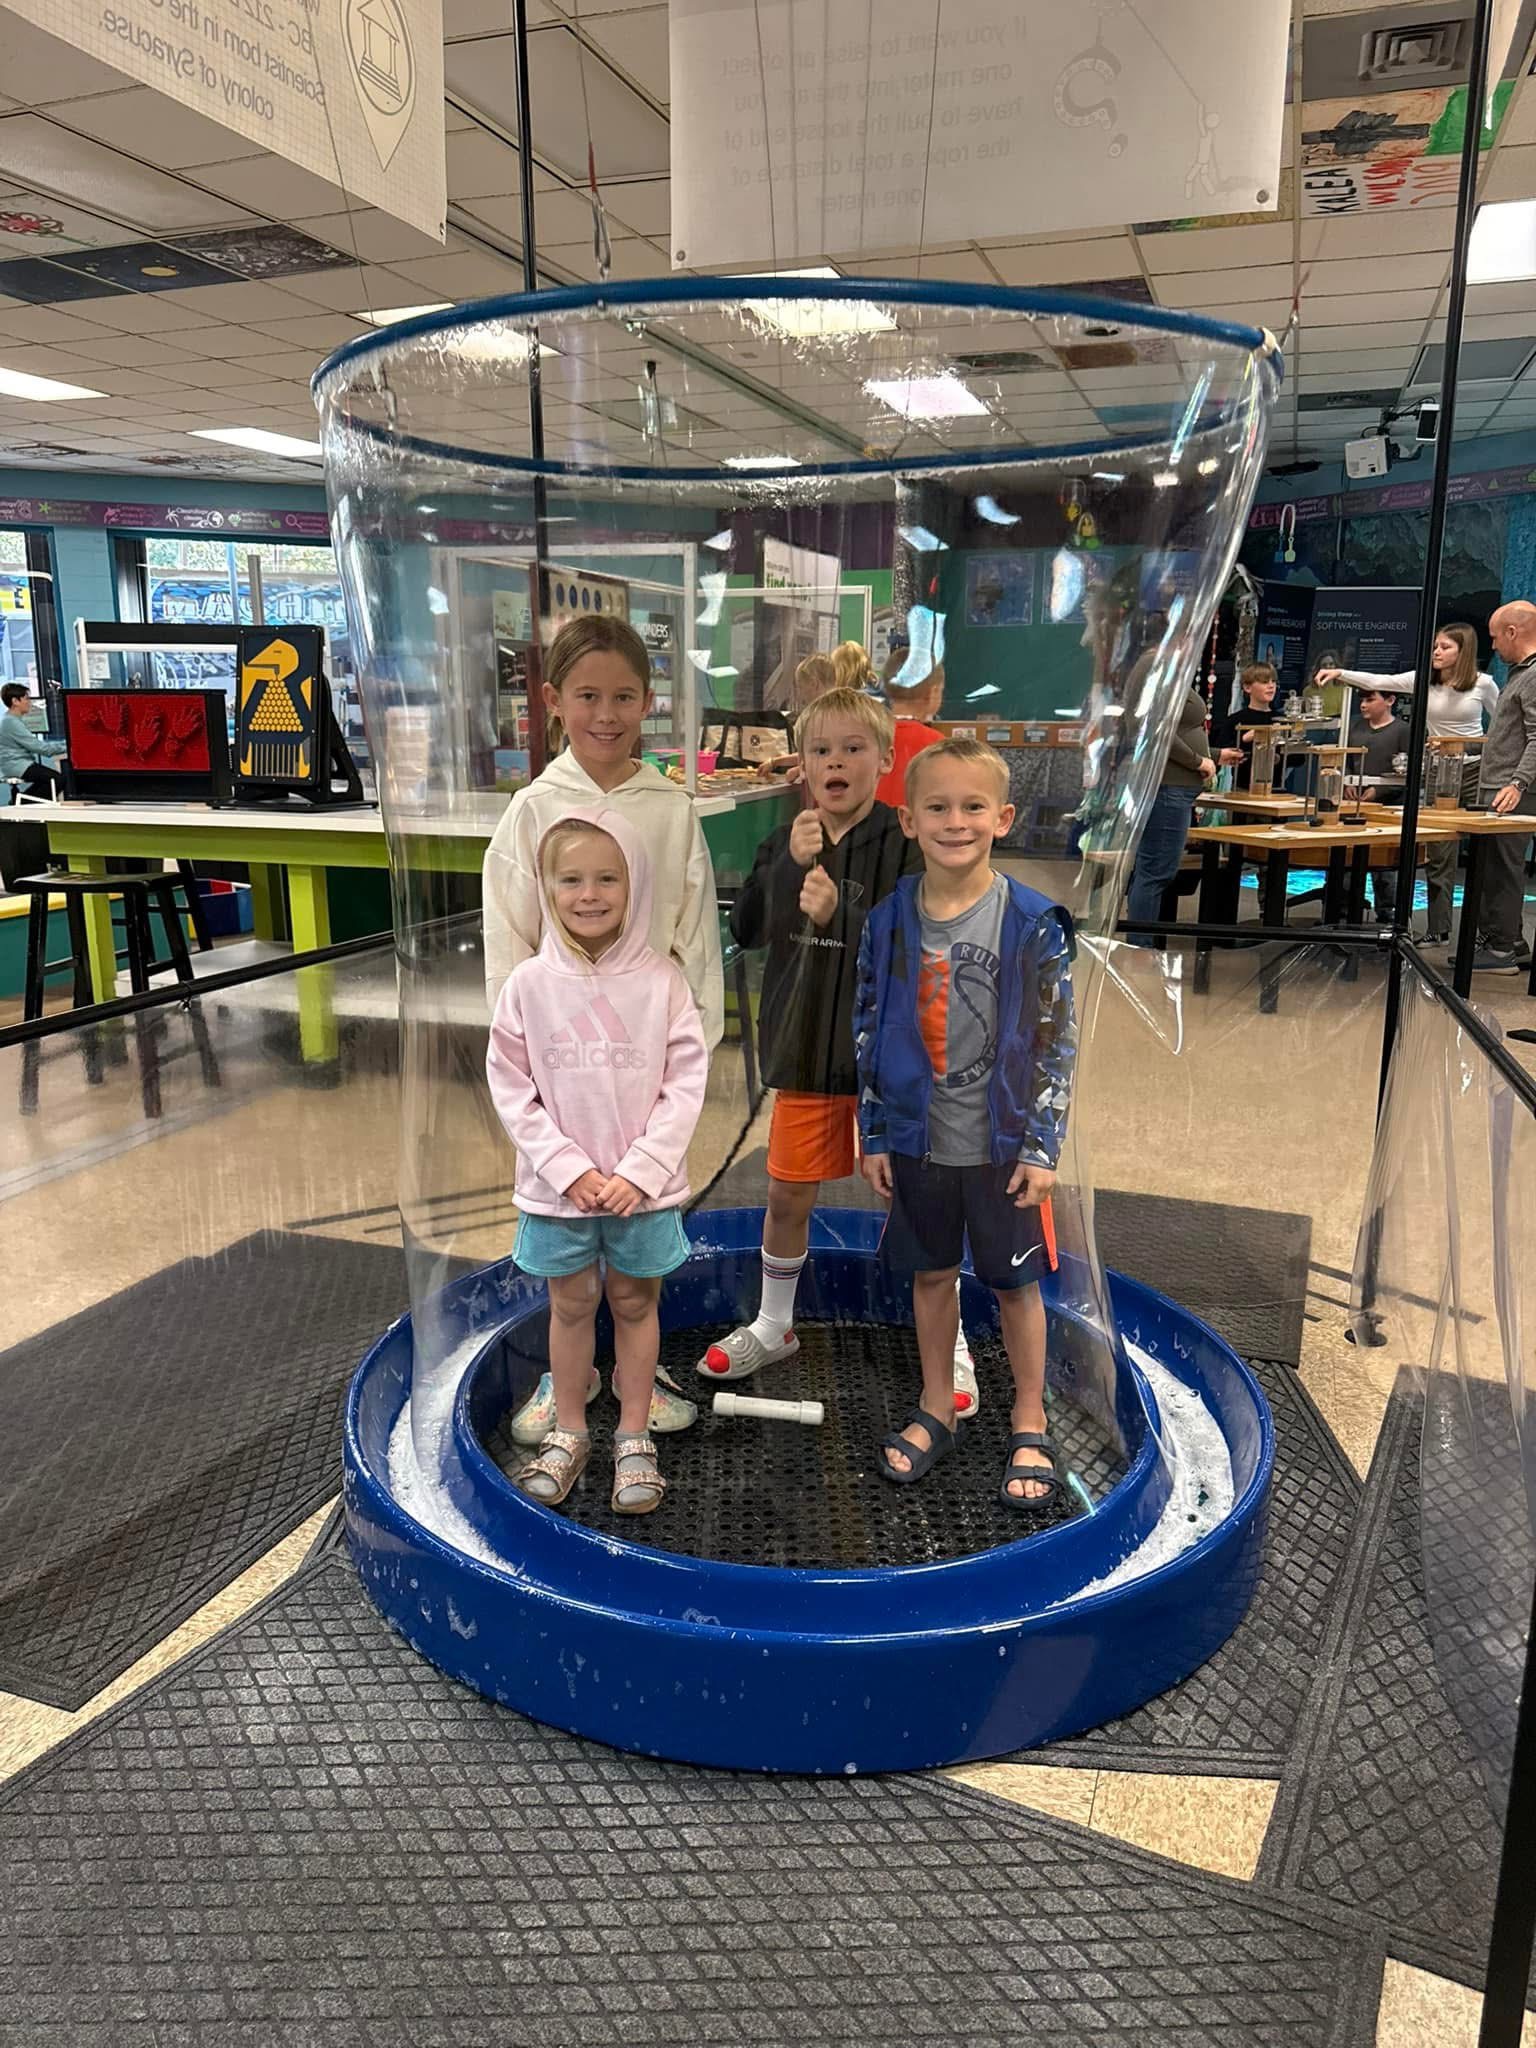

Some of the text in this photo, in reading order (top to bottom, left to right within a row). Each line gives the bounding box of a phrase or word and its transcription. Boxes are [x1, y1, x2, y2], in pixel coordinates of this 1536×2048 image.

[1303, 167, 1364, 215] KALEA
[1316, 621, 1363, 631] SOFTWARE
[1365, 621, 1408, 631] ENGINEER
[542, 1041, 648, 1070] adidas
